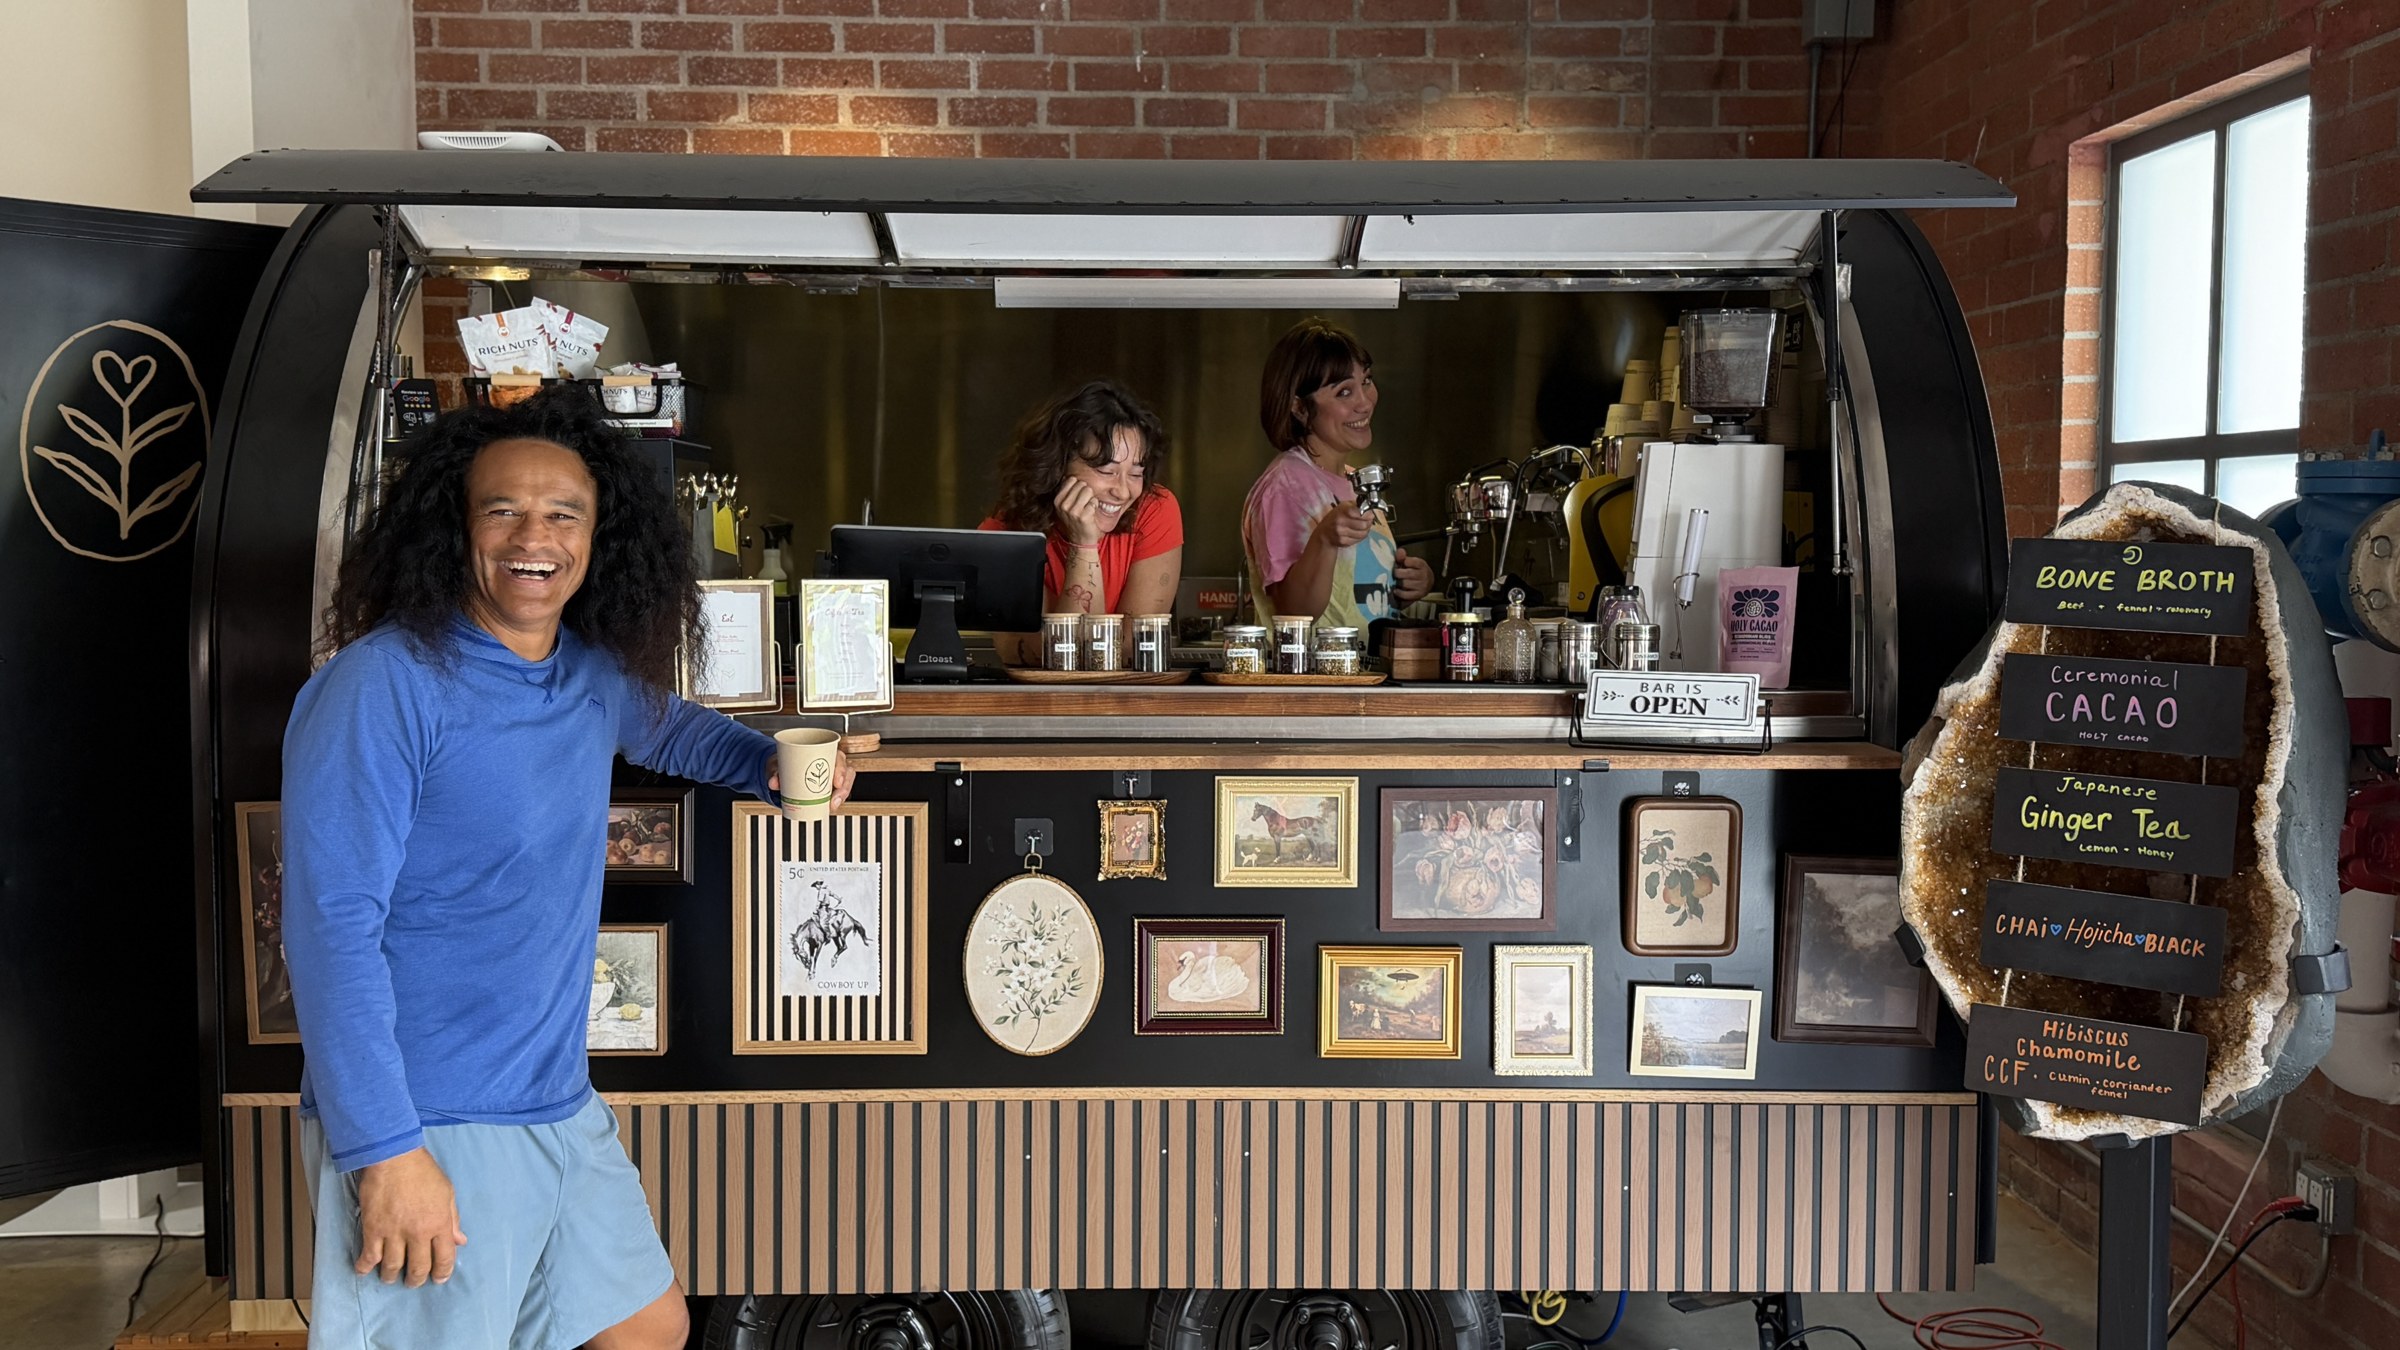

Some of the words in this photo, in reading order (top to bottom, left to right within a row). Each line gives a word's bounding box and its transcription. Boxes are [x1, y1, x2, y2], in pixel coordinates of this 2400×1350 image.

[478, 344, 506, 356] RICH
[509, 338, 538, 351] NUTS
[560, 340, 589, 356] NUTS
[2036, 566, 2116, 591] BONE
[2137, 569, 2235, 593] BROTH
[1199, 592, 1238, 603] HAND
[2057, 601, 2085, 610] Beef
[1731, 620, 1748, 632] HOLY
[1750, 620, 1778, 632] CACAO
[929, 655, 953, 663] toast
[2051, 665, 2179, 691] Ceremonial
[1640, 682, 1675, 693] BAR
[1686, 683, 1702, 694] IS
[1630, 695, 1710, 716] OPEN
[2045, 691, 2178, 729] CACAO
[2079, 731, 2108, 742] HOLY
[2117, 734, 2149, 742] CACAO
[2056, 777, 2158, 801] Japanese
[2020, 795, 2113, 842] Ginger
[2131, 808, 2191, 840] Tea
[2079, 843, 2119, 854] Lemon
[2138, 846, 2175, 861] Honey
[2064, 917, 2136, 949] Hojicha
[2143, 933, 2206, 957] BLACK
[817, 981, 854, 989] COWBOY
[857, 981, 869, 989] UP
[2042, 1019, 2129, 1047] Hibiscus
[2016, 1038, 2142, 1071] Chamomile
[1984, 1055, 2030, 1086] CCF
[2049, 1071, 2091, 1085] cumin
[2103, 1078, 2173, 1094] corriander
[2091, 1087, 2128, 1099] fennel
